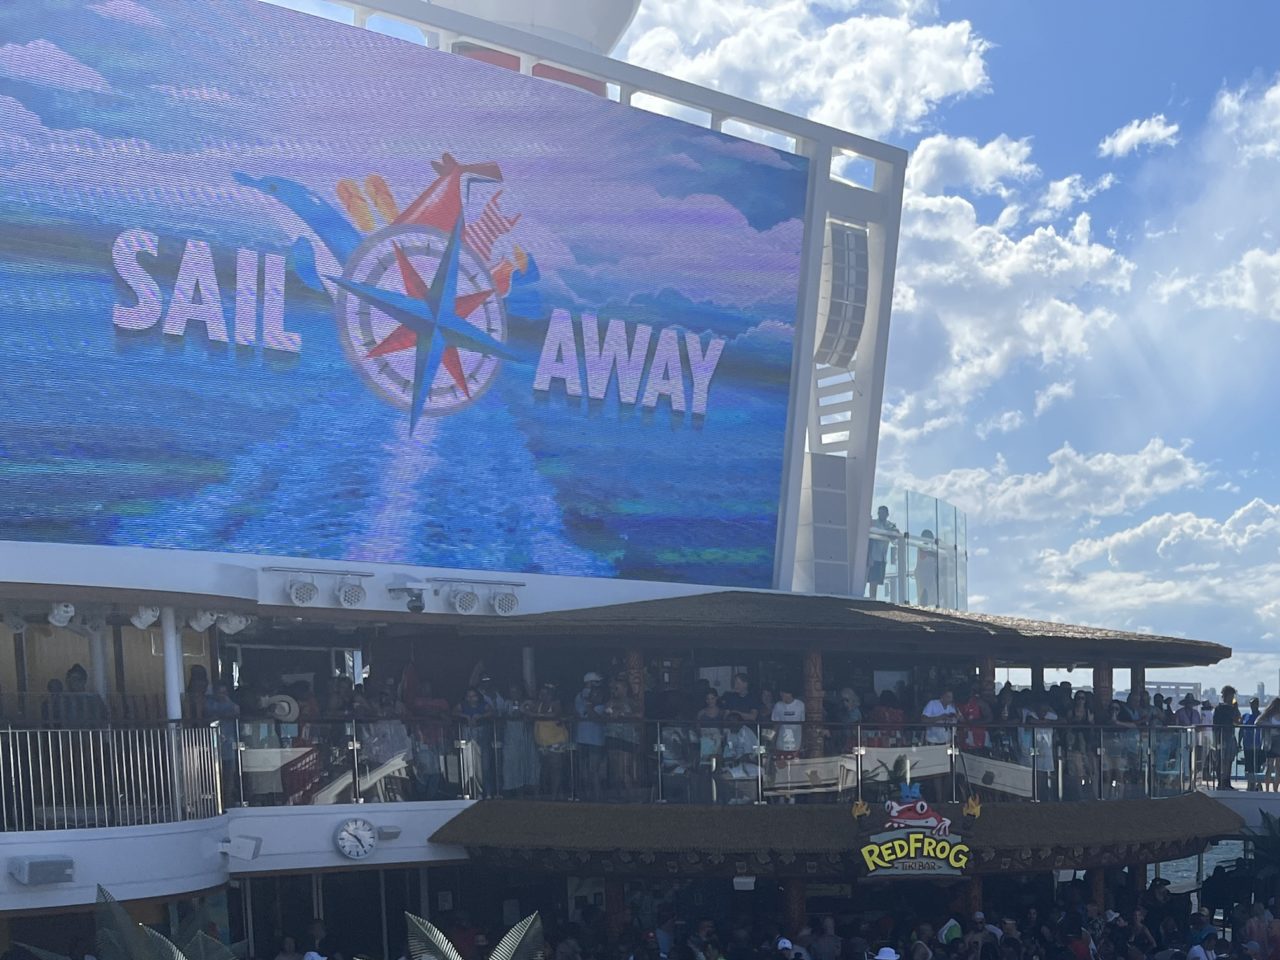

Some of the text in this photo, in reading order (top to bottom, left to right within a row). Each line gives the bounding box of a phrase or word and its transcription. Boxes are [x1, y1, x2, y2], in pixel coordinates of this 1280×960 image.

[112, 227, 726, 415] SAIL AWAY
[918, 861, 936, 871] BAR
